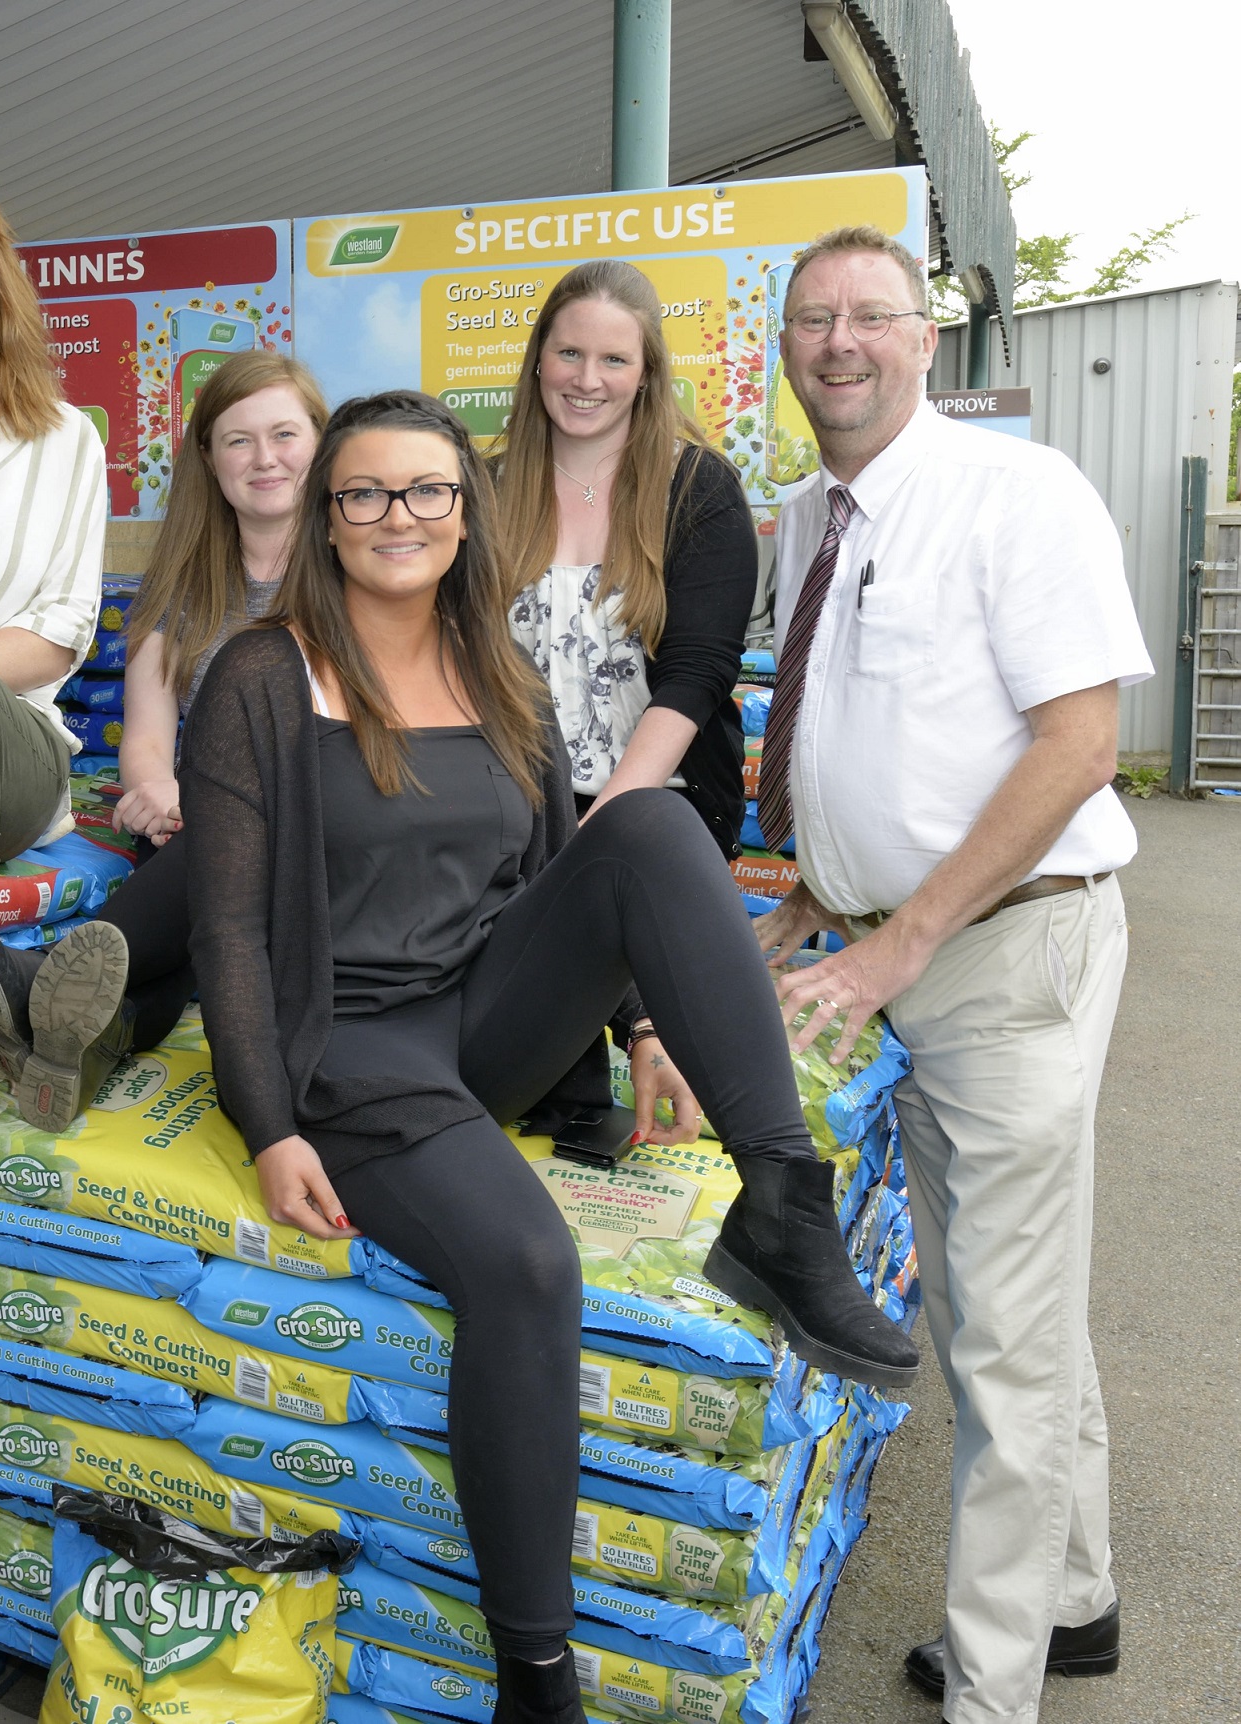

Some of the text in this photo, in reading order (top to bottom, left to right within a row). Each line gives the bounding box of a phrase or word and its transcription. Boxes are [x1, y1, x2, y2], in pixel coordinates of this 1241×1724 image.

[455, 201, 735, 255] SPECIFIC USE
[38, 250, 145, 287] INNES
[42, 312, 90, 330] Innes
[446, 307, 519, 331] Seed &
[446, 341, 527, 357] The perfect
[446, 362, 521, 381] germinati
[929, 397, 998, 413] MPROVE
[734, 864, 778, 881] Innes
[123, 1068, 161, 1100] Super
[547, 1168, 686, 1198] Fine Grade
[561, 1180, 667, 1205] for 25% more
[76, 1177, 231, 1239] Seed & Cutting
[571, 1190, 655, 1210] germination
[580, 1201, 642, 1216] ENRICHED
[107, 1203, 201, 1244] Compost
[563, 1204, 658, 1226] WITH SEAWEED
[592, 1217, 624, 1227] ADDED
[6, 1212, 17, 1225] &
[18, 1214, 64, 1237] Cutting
[66, 1223, 122, 1248] Compost
[582, 1219, 635, 1233] VERMICULITE
[605, 1300, 674, 1331] Compost
[78, 1312, 231, 1377] Seed & Cutting
[5, 1349, 14, 1361] &
[16, 1351, 60, 1376] Cutting
[61, 1363, 116, 1388] Compost
[107, 1341, 199, 1381] Compost
[621, 1388, 666, 1403] WHEN LIFTING
[627, 1383, 661, 1396] TAKE CARE
[689, 1390, 735, 1411] Super
[614, 1409, 668, 1427] WHEN FILLED
[694, 1405, 726, 1422] Fine
[688, 1416, 729, 1433] Grade
[606, 1451, 676, 1479] Compost
[16, 1472, 26, 1484] &
[75, 1446, 227, 1510] Seed & Cutting
[368, 1465, 447, 1502] Seed &
[103, 1474, 195, 1514] Compost
[609, 1535, 653, 1551] WHEN LIFTING
[615, 1530, 647, 1543] TAKE CARE
[675, 1540, 720, 1561] Super
[602, 1555, 654, 1574] WHEN FILLED
[680, 1556, 711, 1571] Fine
[674, 1567, 714, 1585] Grade
[374, 1596, 452, 1636] Seed &
[590, 1591, 657, 1621] Compost
[103, 1673, 140, 1699] FINE
[611, 1676, 655, 1692] WHEN LIFTING
[617, 1672, 650, 1685] TAKE CARE
[677, 1681, 723, 1703] Super
[683, 1696, 714, 1714] Fine
